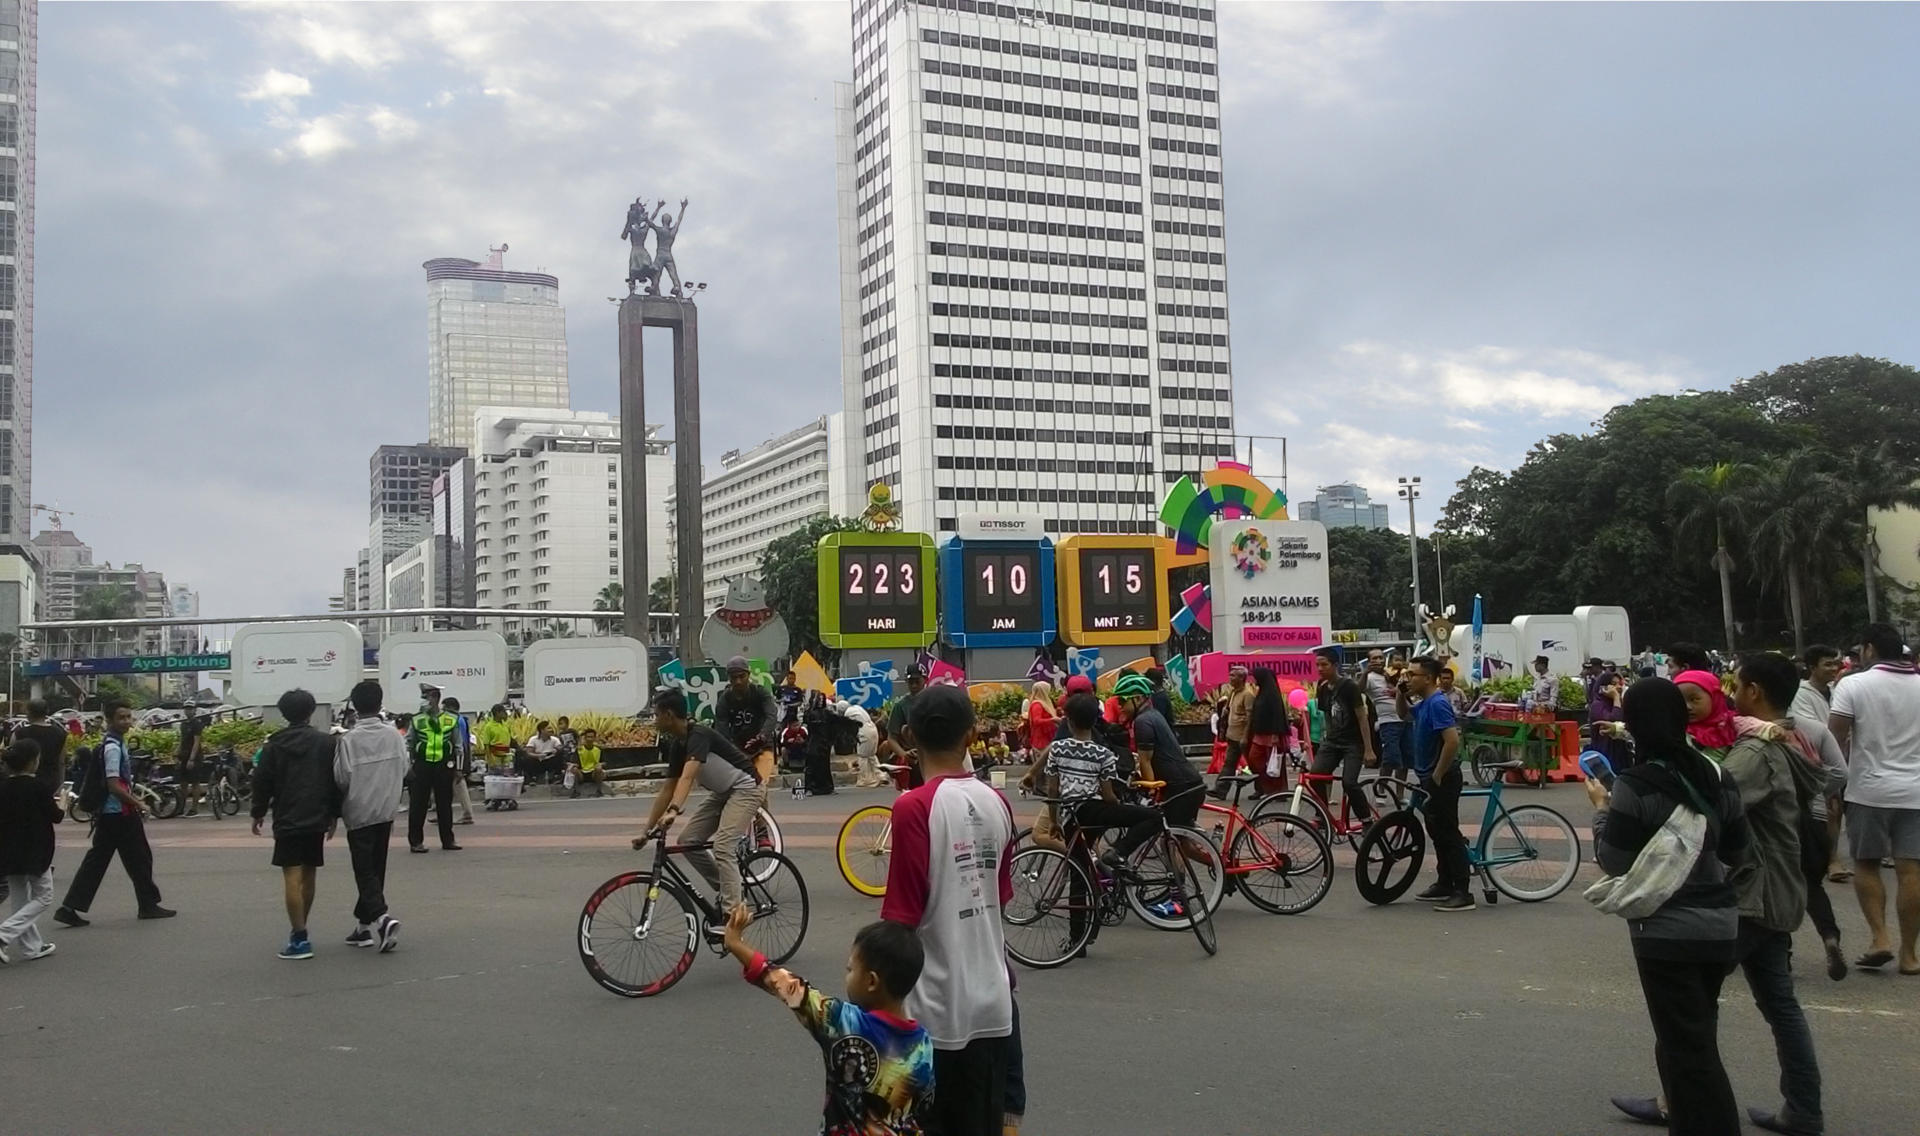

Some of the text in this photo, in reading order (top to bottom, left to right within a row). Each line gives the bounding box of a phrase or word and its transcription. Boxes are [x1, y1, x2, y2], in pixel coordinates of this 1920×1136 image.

[993, 520, 1026, 528] TISSOT
[1278, 542, 1308, 550] Jakarta
[1279, 551, 1322, 560] Palembang
[1279, 560, 1298, 568] 2018
[982, 564, 1026, 595] 10
[1098, 564, 1141, 594] 15
[1241, 596, 1320, 608] ASIAN GAMES
[868, 618, 896, 630] HARI
[992, 618, 1016, 629] JAM
[1094, 616, 1119, 627] MNT
[1248, 631, 1318, 641] ENERGY OF ASIA
[131, 655, 229, 670] Ayo Dukung
[467, 667, 486, 676] BNI
[589, 674, 620, 682] mandiri
